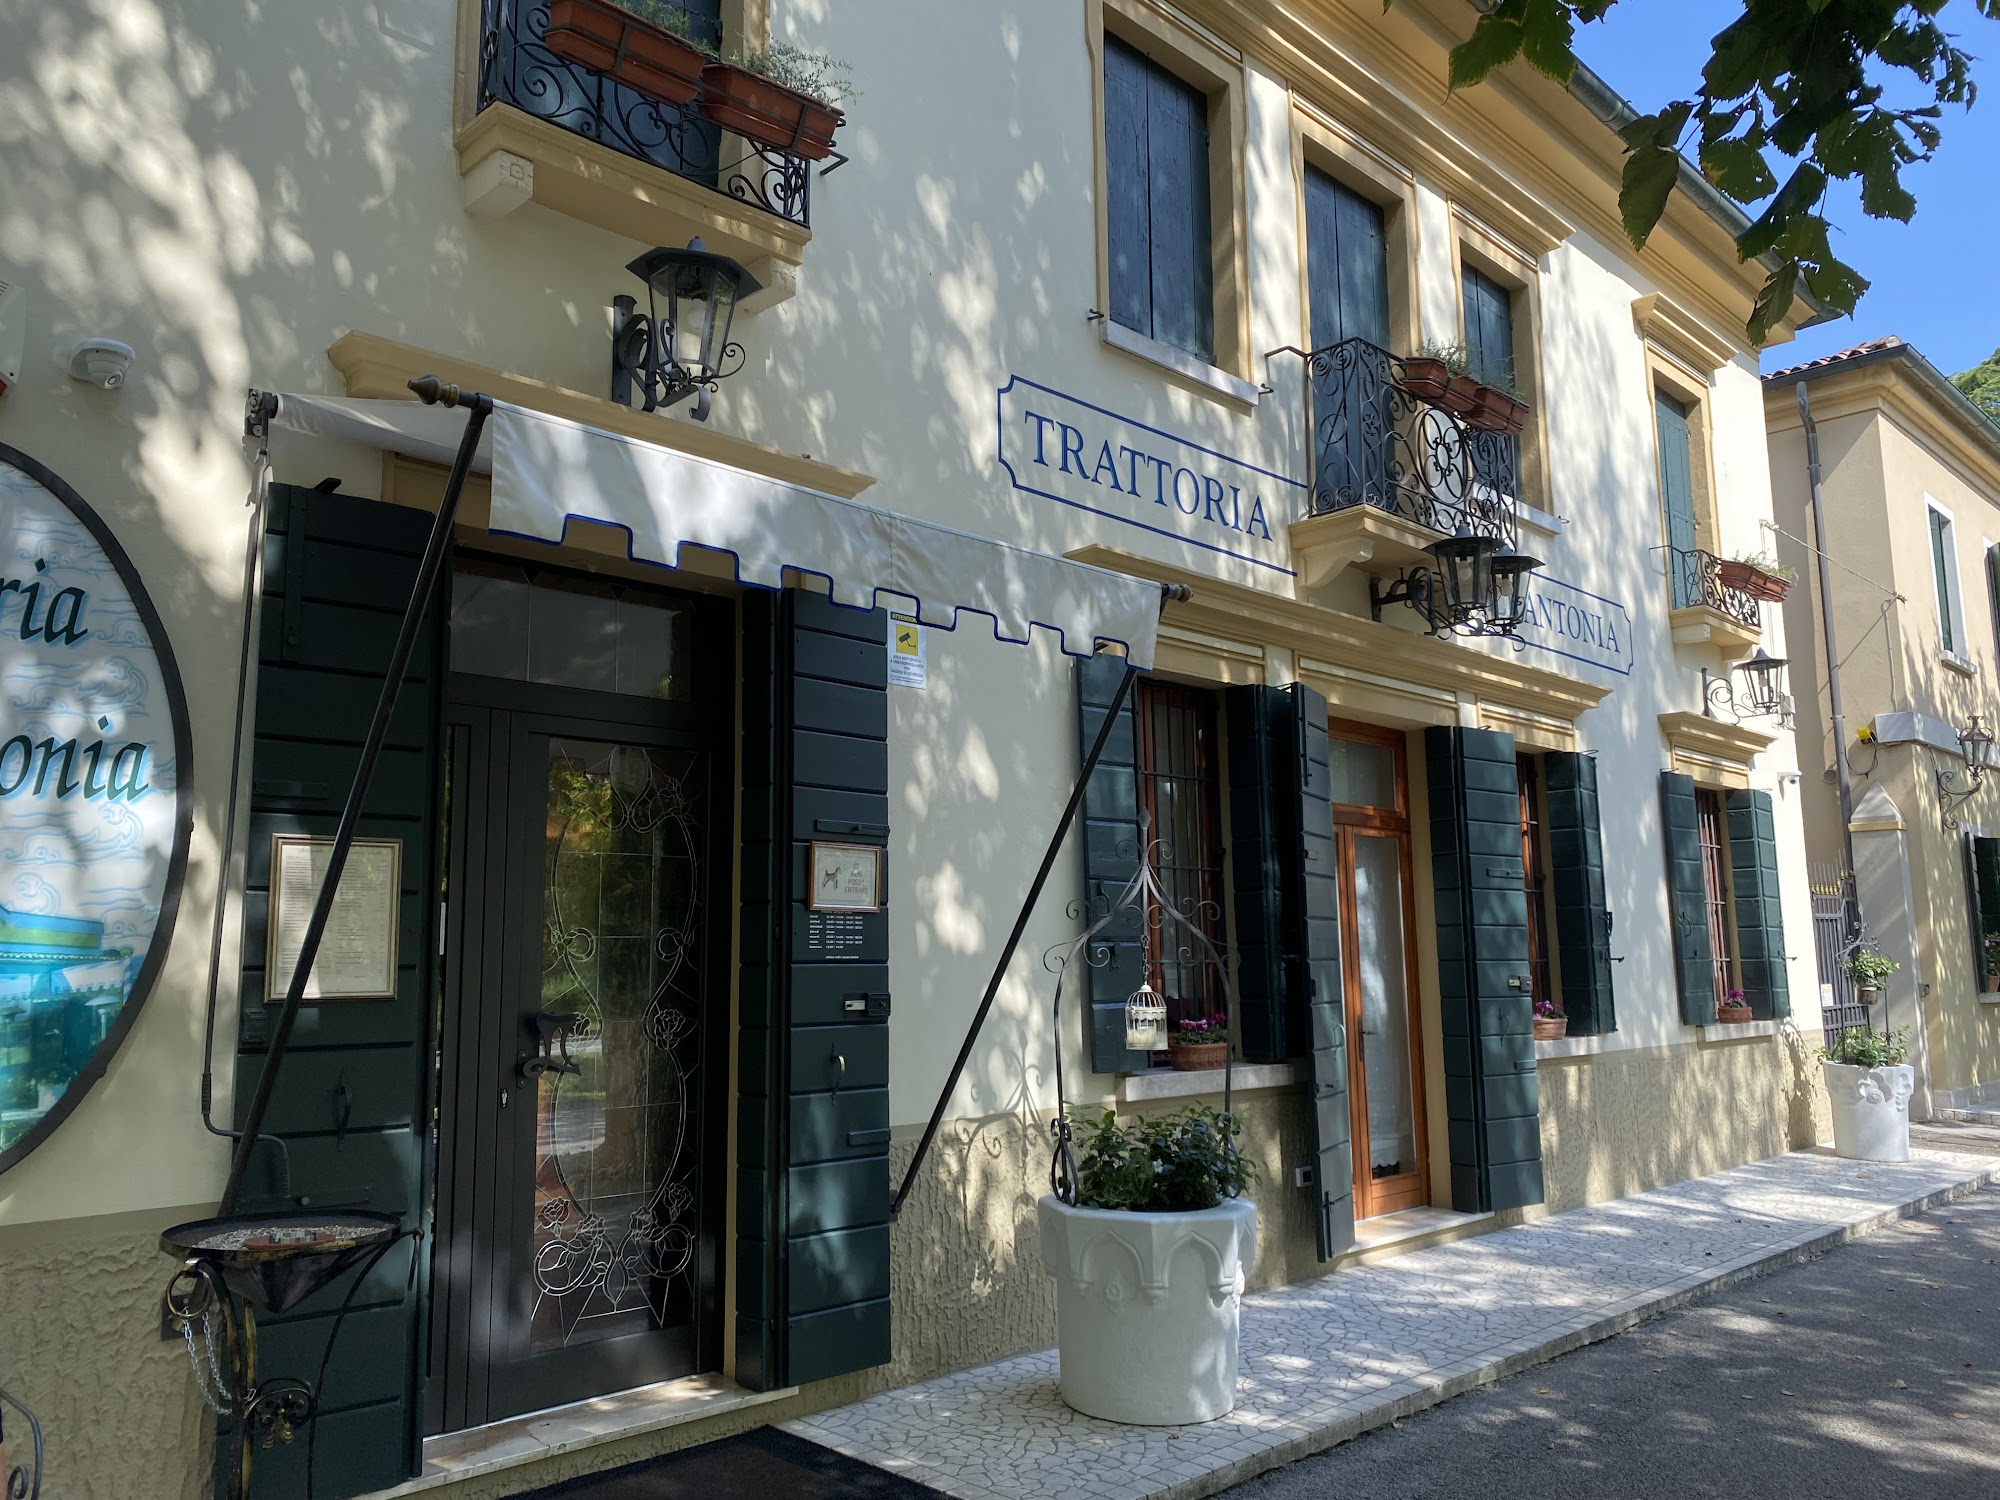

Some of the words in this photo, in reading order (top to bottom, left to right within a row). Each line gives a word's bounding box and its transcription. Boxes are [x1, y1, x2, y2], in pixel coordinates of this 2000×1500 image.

[1024, 410, 1273, 541] TRATTORIA
[892, 613, 917, 623] ATTENZION
[1523, 591, 1620, 654] ANTONIA
[845, 886, 868, 895] ENTRARE
